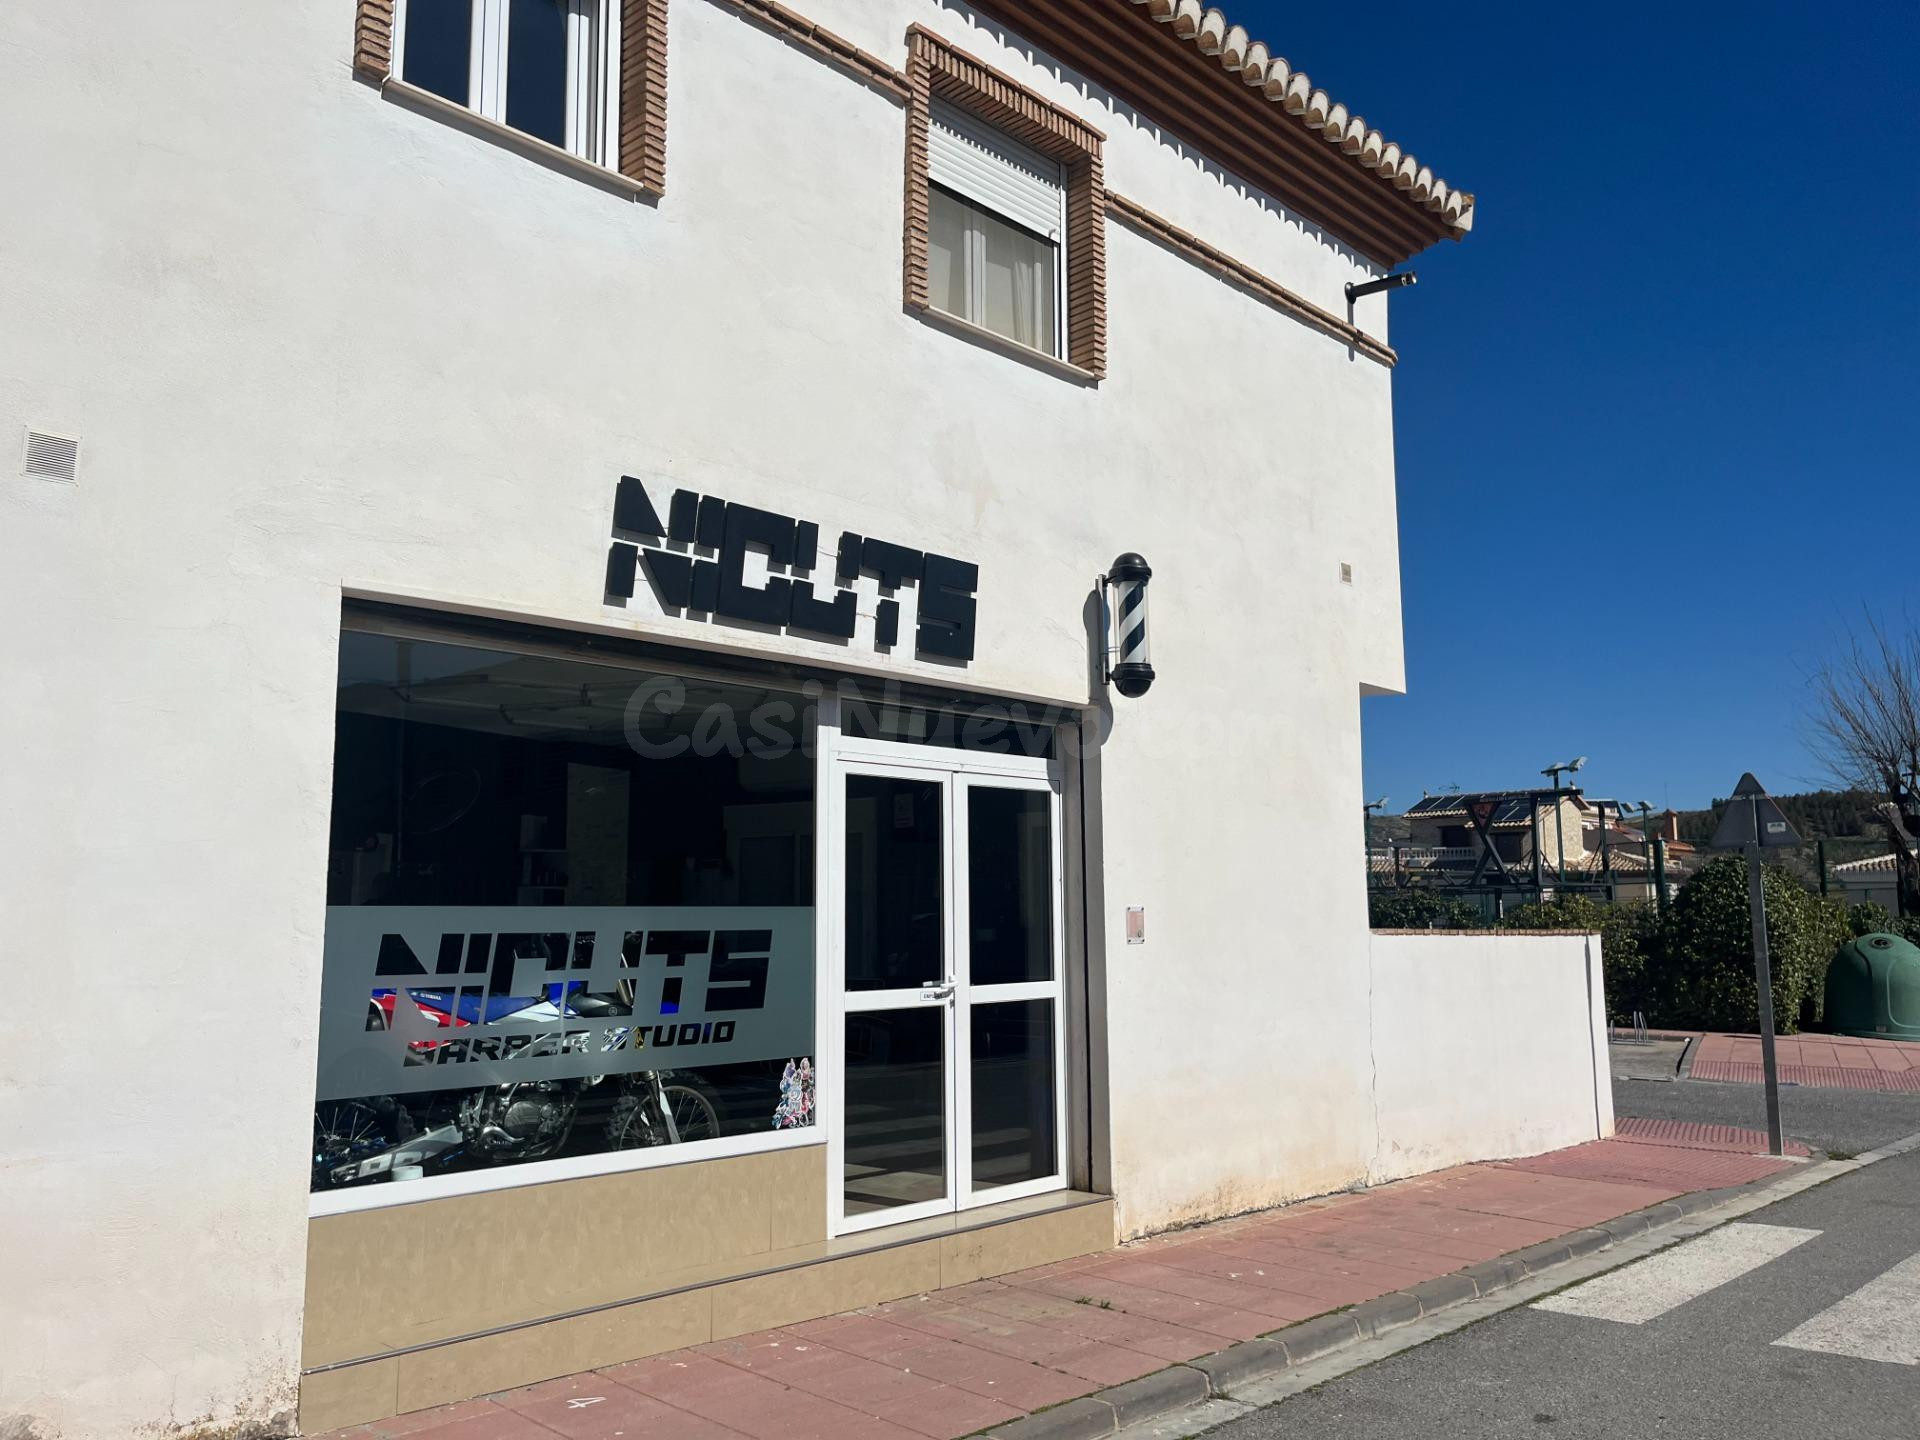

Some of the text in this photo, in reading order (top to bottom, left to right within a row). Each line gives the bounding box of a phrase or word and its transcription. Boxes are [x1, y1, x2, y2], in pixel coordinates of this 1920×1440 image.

[606, 475, 979, 661] NICUTS
[365, 929, 772, 1031] NICUTS
[403, 1020, 736, 1067] BARBER STUDIO
